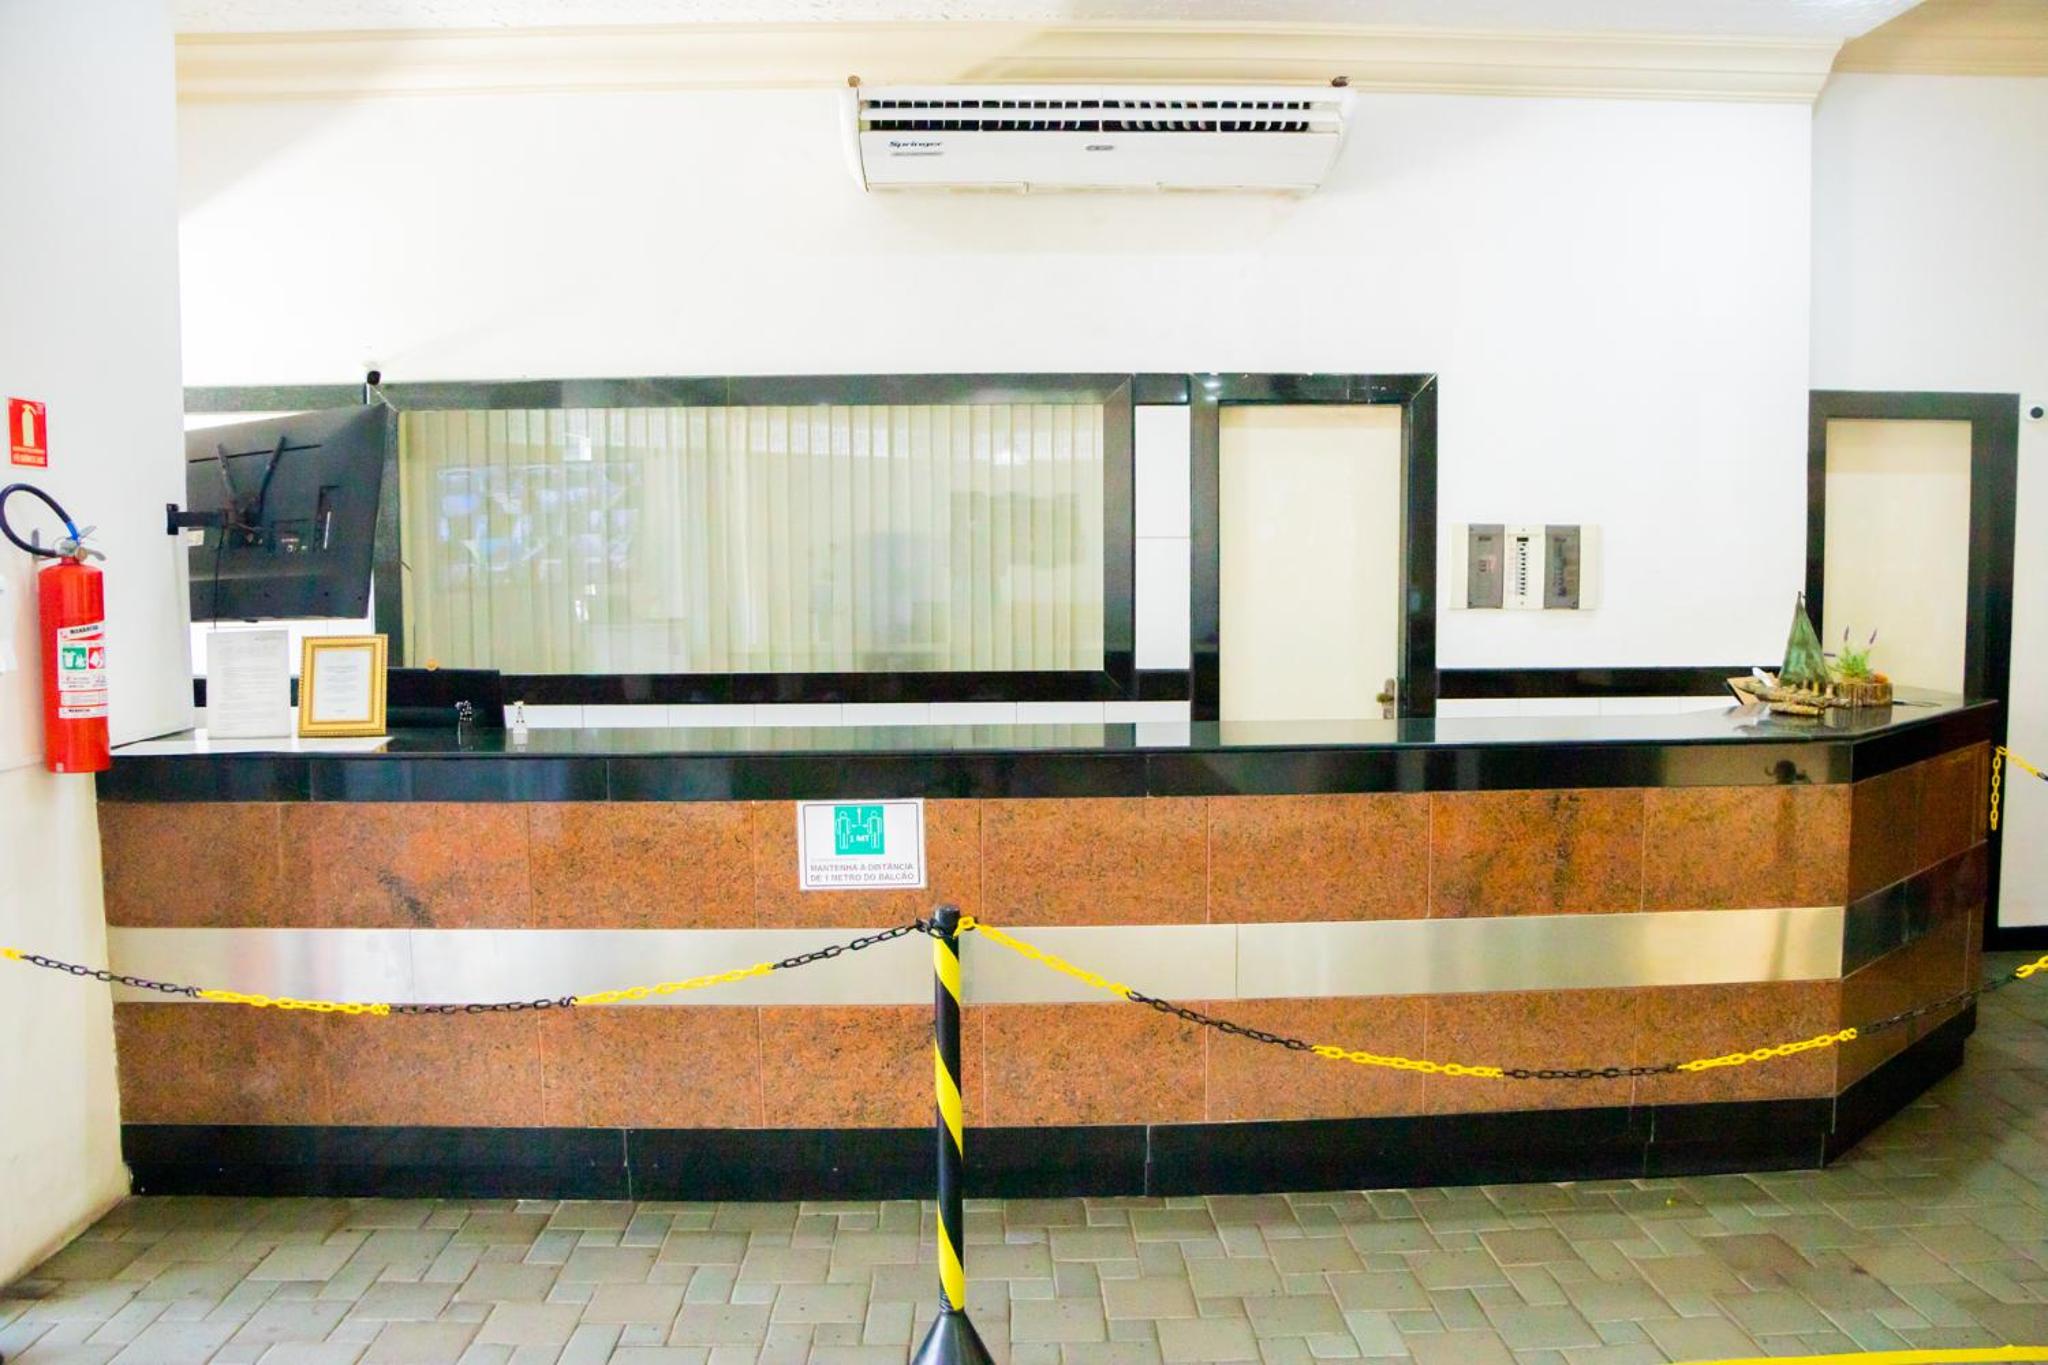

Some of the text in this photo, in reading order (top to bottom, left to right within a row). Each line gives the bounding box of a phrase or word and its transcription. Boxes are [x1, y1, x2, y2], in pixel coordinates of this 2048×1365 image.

[810, 864, 858, 872] MANTENHA
[831, 873, 862, 881] METRO
[863, 873, 877, 881] DO
[878, 872, 915, 881] BALCÃO
